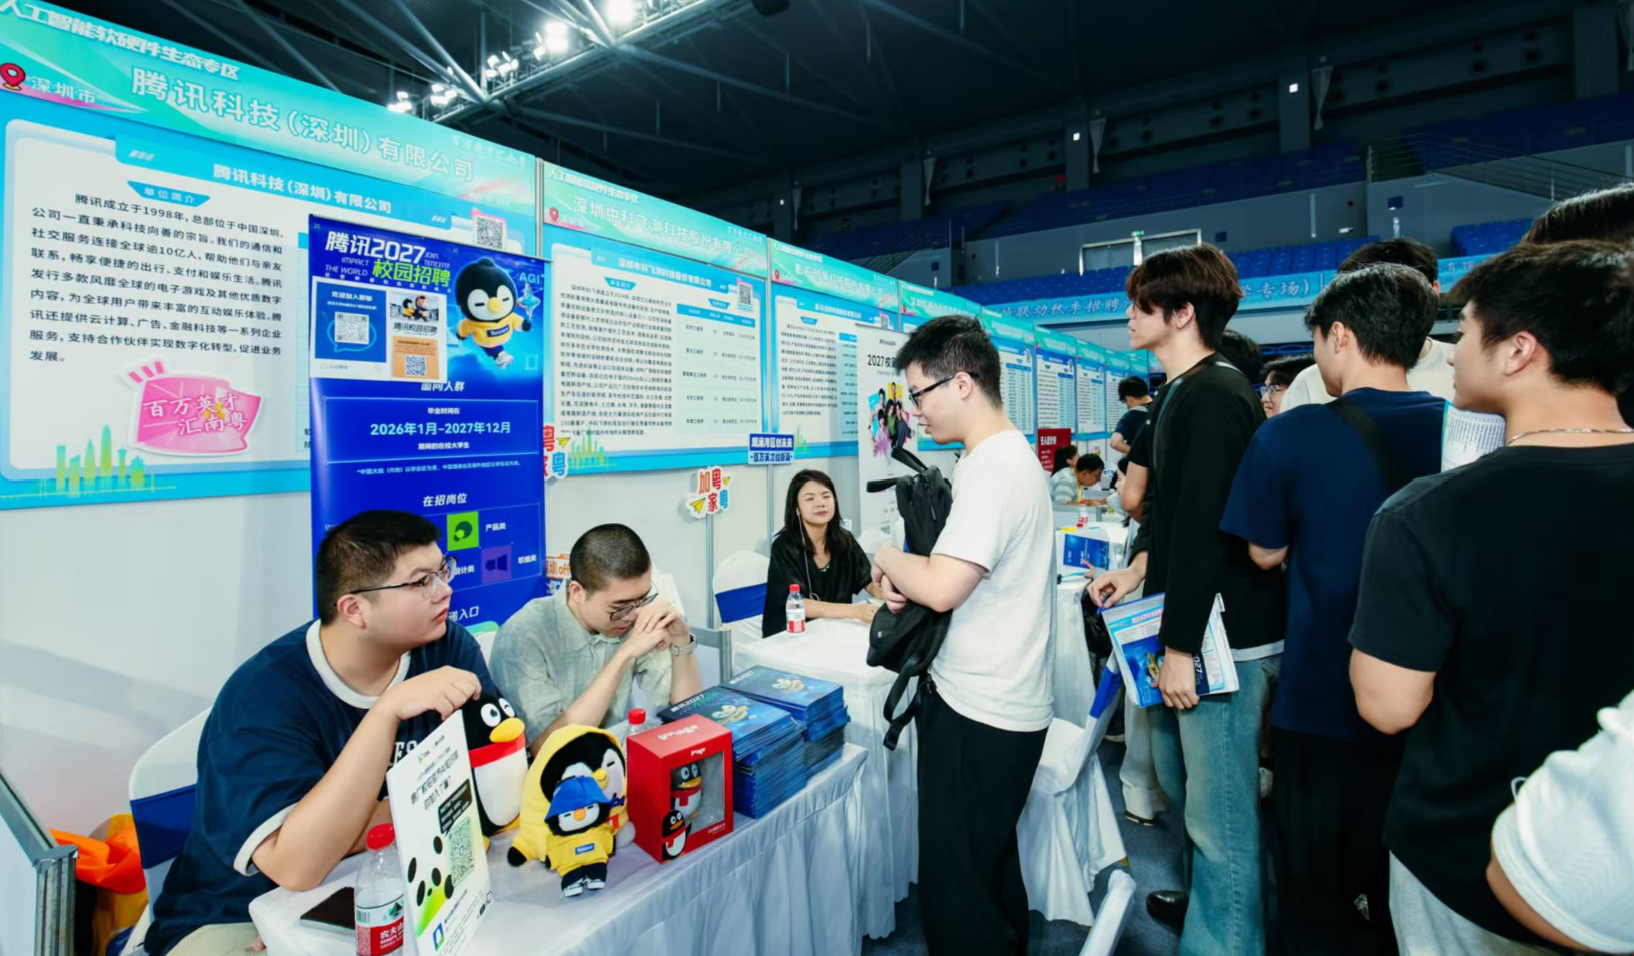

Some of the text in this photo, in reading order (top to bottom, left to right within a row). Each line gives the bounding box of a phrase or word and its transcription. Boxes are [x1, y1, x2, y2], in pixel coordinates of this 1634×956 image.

[0, 0, 241, 81] 人工智能软硬件生态专区
[31, 76, 96, 104] 深圳市
[132, 66, 473, 181] 腾讯科技（深圳）有限公司
[213, 163, 392, 214] 腾讯科技（深圳）有限公司
[325, 230, 426, 264] 腾讯2027
[325, 264, 368, 276] THE WORLD
[372, 258, 451, 287] 校园招聘
[519, 271, 540, 284] AGI
[29, 350, 66, 362] 发展。
[143, 393, 238, 418] 百万英才
[177, 411, 247, 436] 汇南粤
[422, 492, 467, 508] 在招岗位
